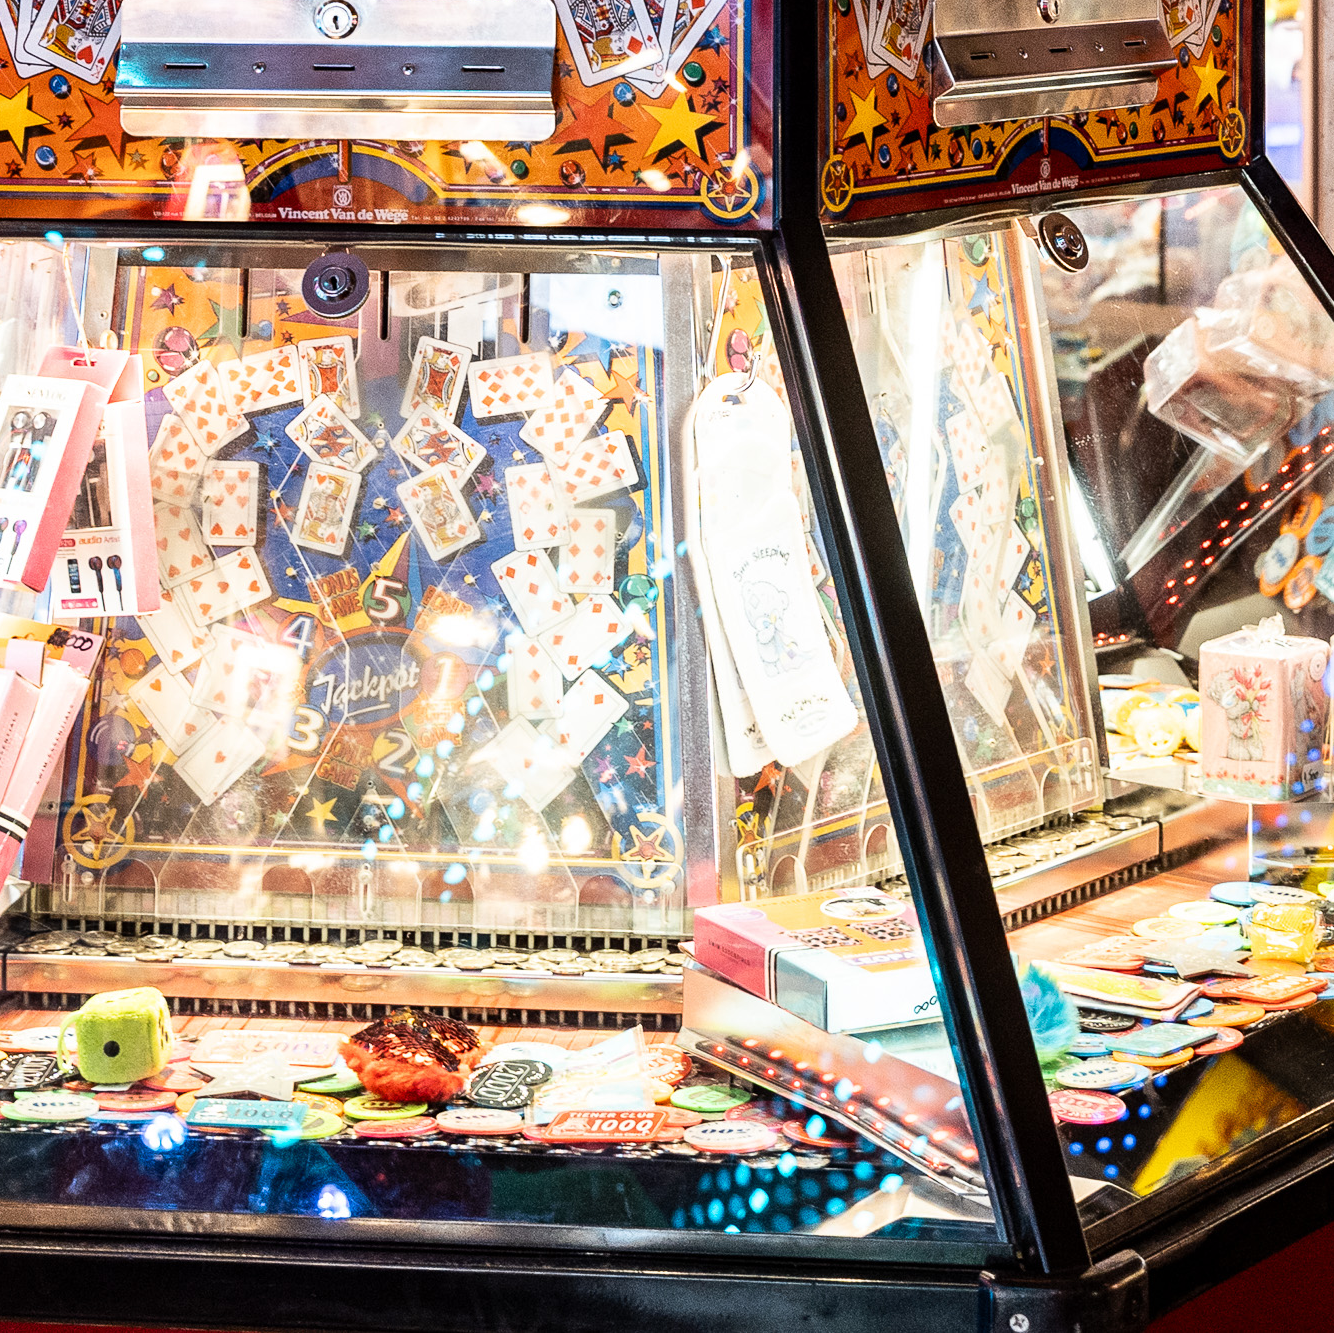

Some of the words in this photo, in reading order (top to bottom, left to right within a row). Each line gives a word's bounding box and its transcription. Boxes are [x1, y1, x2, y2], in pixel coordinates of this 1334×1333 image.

[1011, 182, 1039, 195] Vincent
[1039, 179, 1052, 191] Van
[1052, 177, 1062, 190] de
[1061, 176, 1080, 189] Wege
[278, 206, 331, 221] Vincent
[330, 208, 356, 221] Van
[357, 208, 374, 221] de
[374, 208, 409, 224] Wege
[308, 568, 361, 604] BONUS
[369, 577, 405, 620] 5
[282, 615, 314, 658] 4
[312, 660, 421, 715] Jackpot
[287, 704, 325, 753] 3
[379, 731, 413, 775] 2
[568, 1111, 616, 1120] TIENER
[618, 1111, 655, 1120] CLUB
[590, 1119, 655, 1133] 1000
